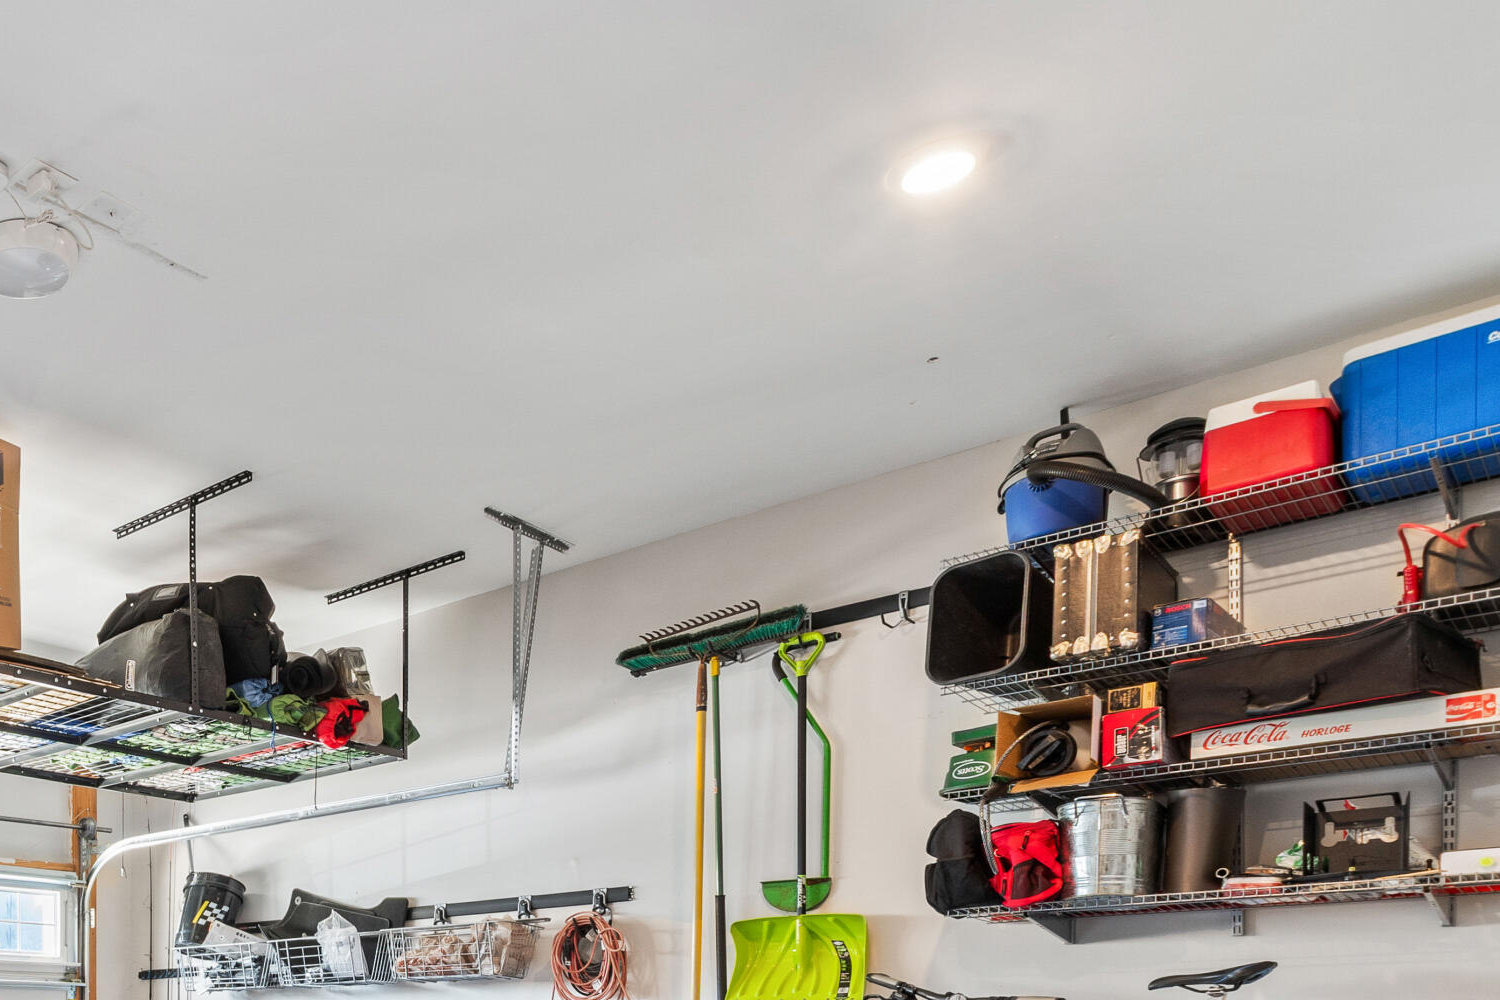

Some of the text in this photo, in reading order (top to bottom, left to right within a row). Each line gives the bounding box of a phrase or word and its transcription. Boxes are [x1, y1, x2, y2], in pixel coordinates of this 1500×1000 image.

[1165, 603, 1192, 614] BOSCH
[1203, 720, 1292, 751] Coca-Cola
[1301, 724, 1352, 738] HORLOGE
